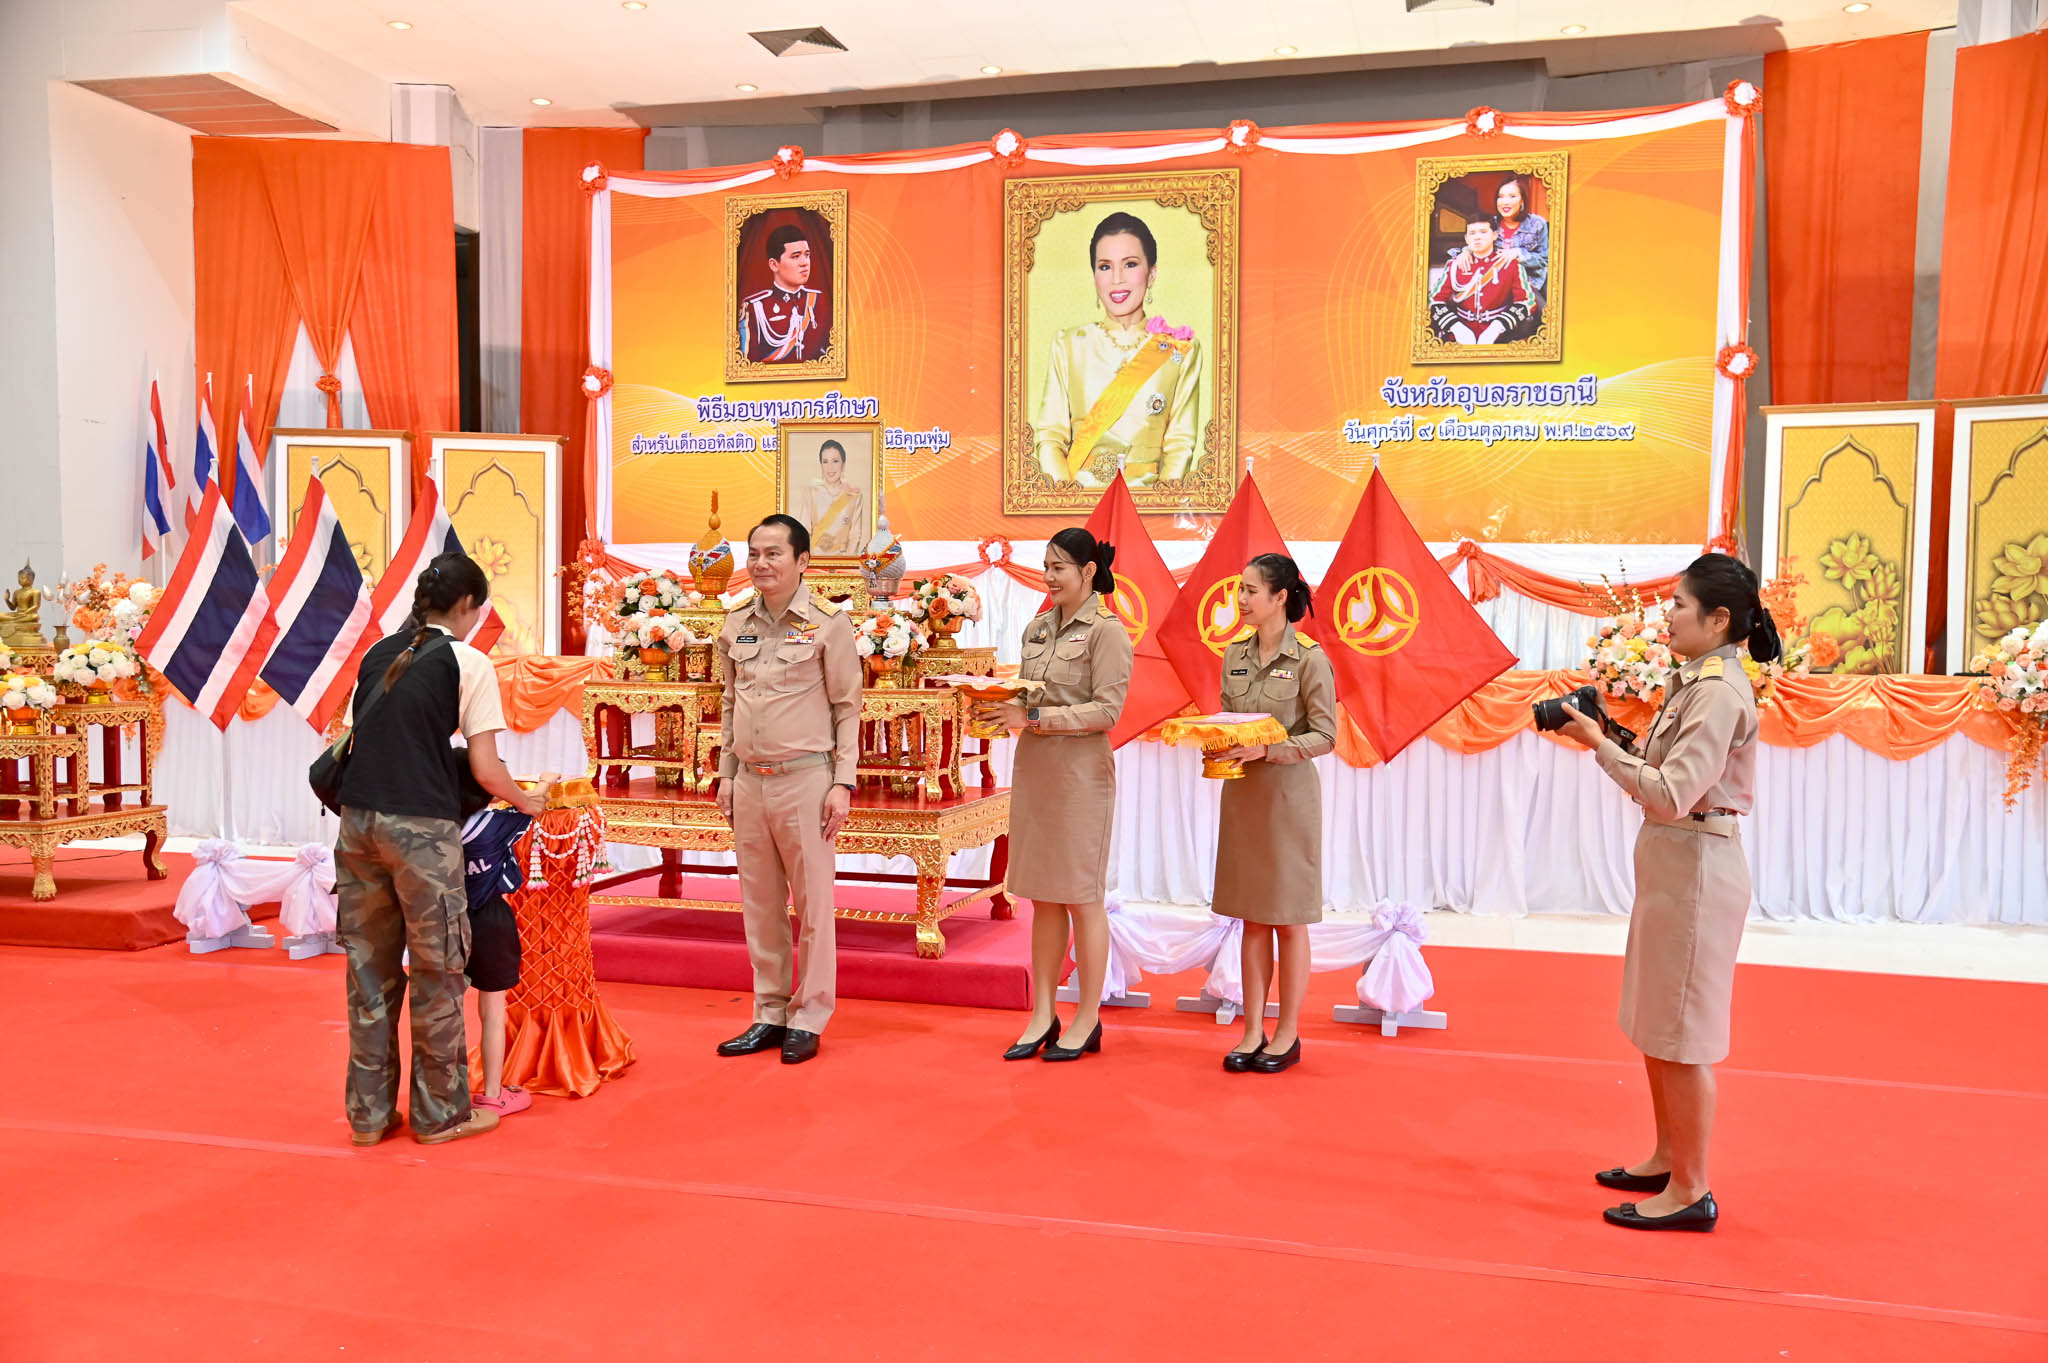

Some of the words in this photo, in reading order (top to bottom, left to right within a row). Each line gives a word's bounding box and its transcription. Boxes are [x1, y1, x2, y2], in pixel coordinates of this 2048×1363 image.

[696, 391, 878, 425] พิธีมอบทุนการศึกษา
[1381, 375, 1595, 412] จังหวัดอุบลราชธานี
[631, 432, 754, 451] สำหรับเด็กออทิสติก
[885, 427, 949, 452] นิธิคุณพุ่ม
[1344, 415, 1411, 445] วันศุกร์ที่
[1418, 424, 1433, 438] ๙
[1438, 419, 1537, 443] เดือนตุลาคม
